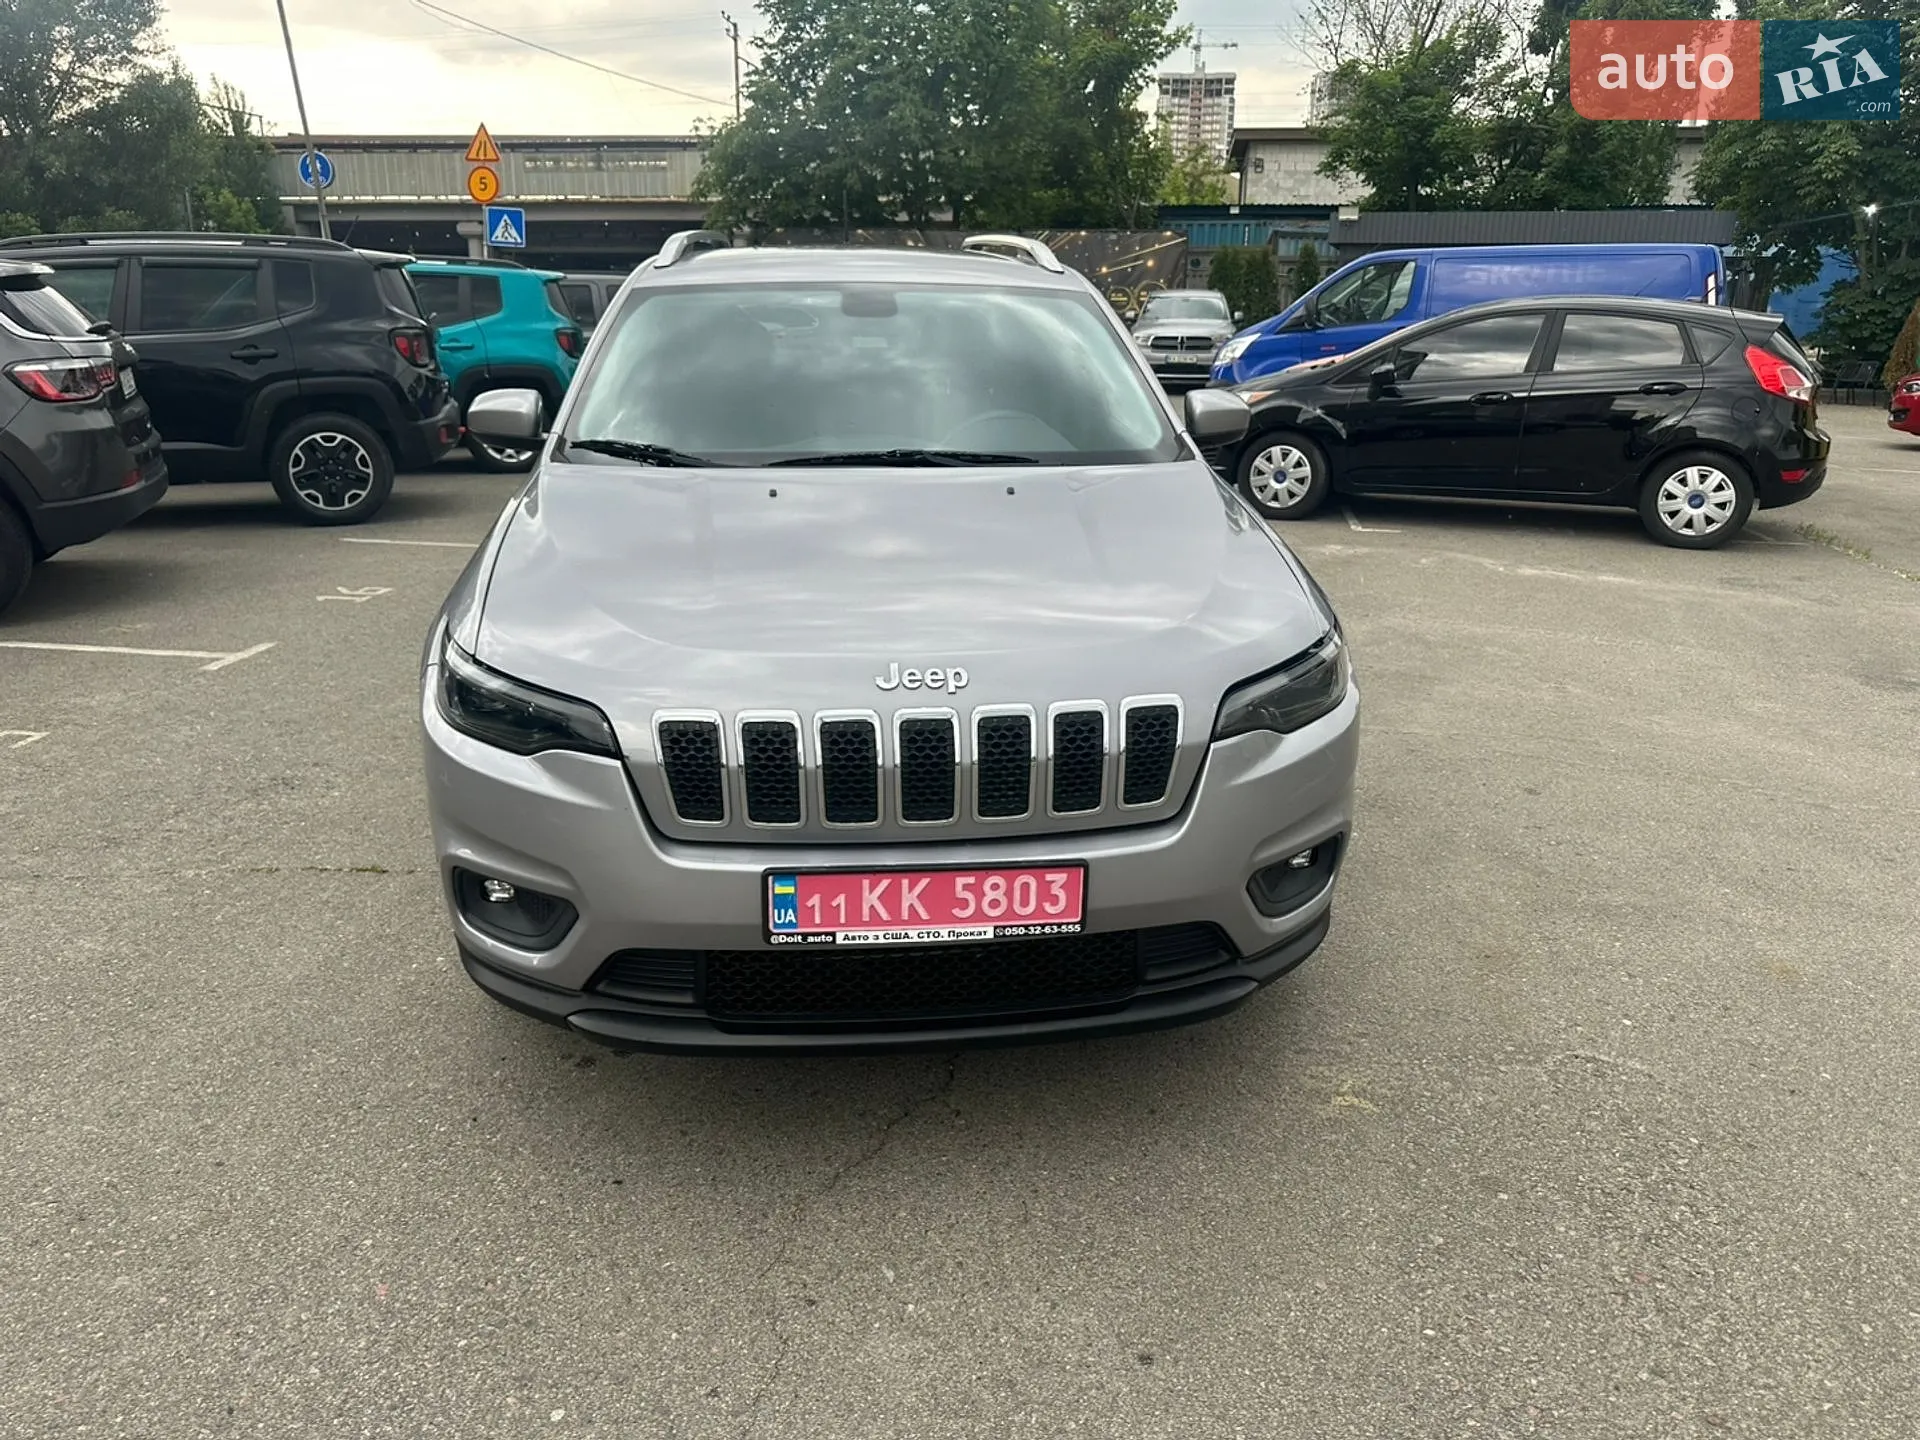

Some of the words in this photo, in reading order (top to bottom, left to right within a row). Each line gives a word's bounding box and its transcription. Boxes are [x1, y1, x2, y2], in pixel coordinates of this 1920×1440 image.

[479, 175, 488, 192] 5
[874, 662, 969, 695] Jeep
[951, 872, 1068, 919] 5803
[773, 908, 797, 924] UA
[842, 933, 870, 942] Авто
[947, 928, 988, 940] Прокат
